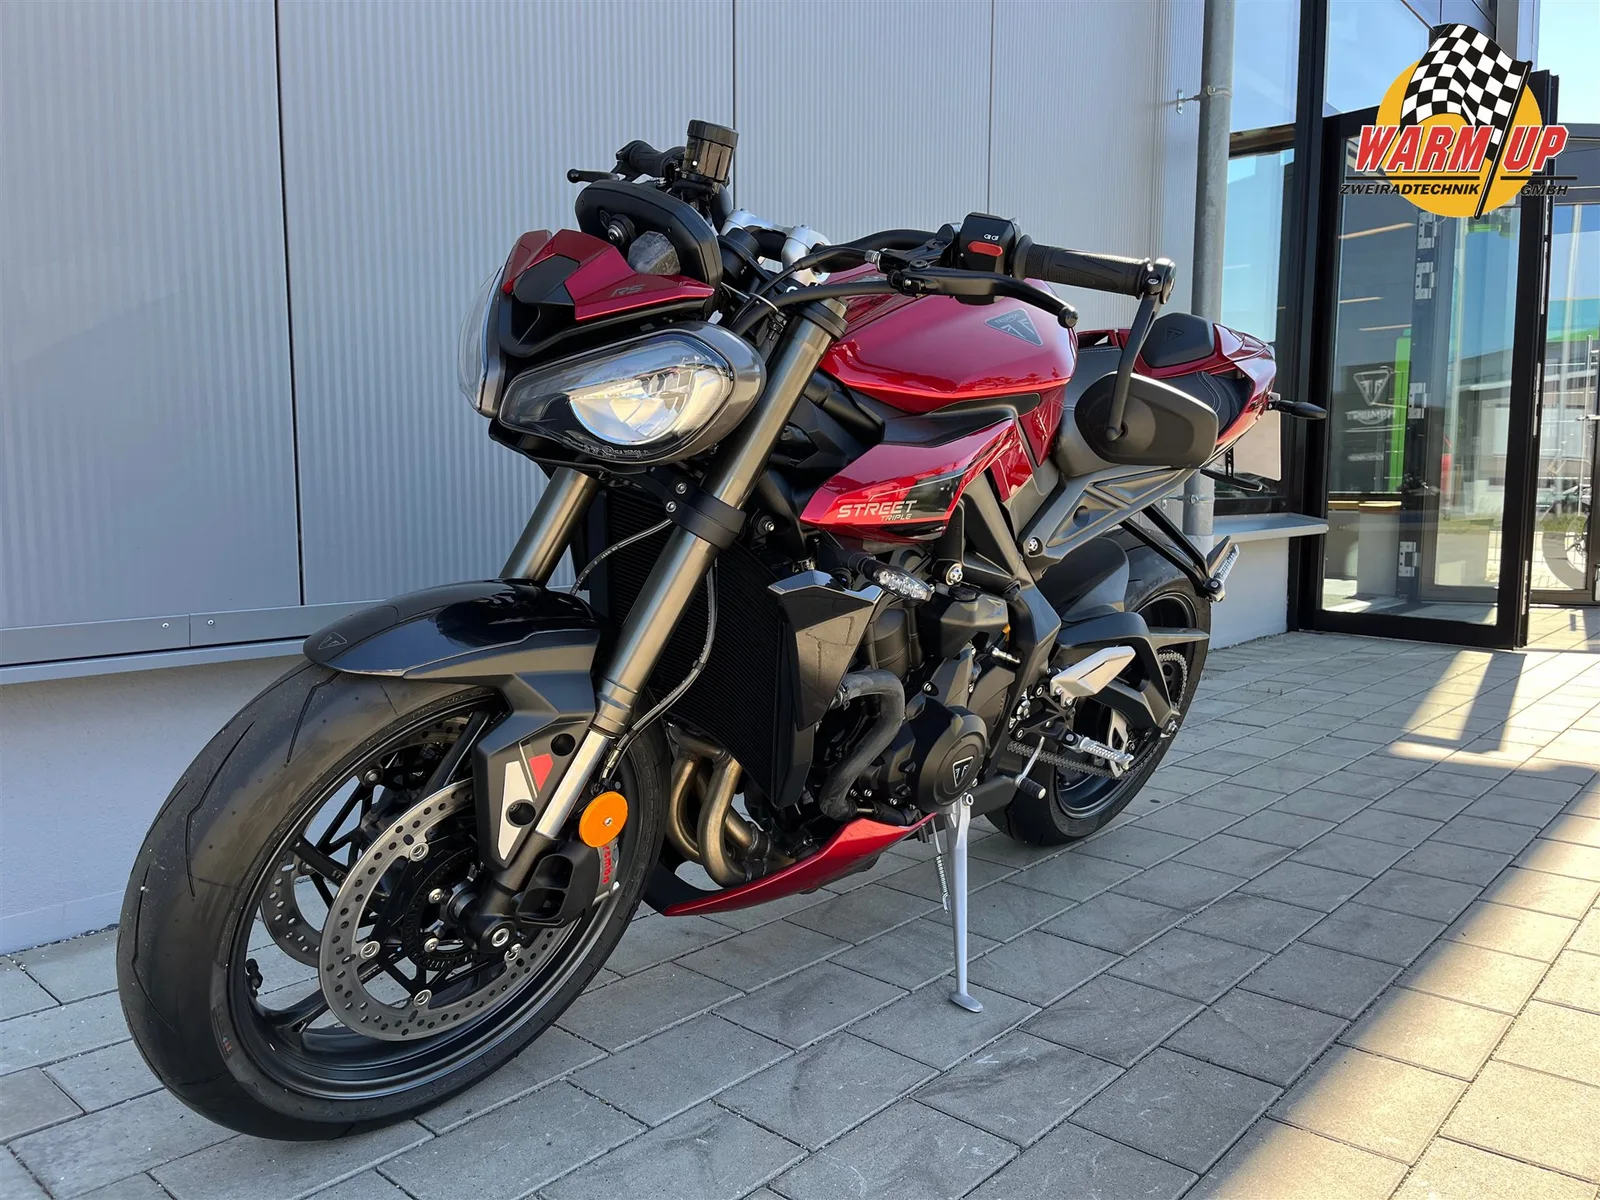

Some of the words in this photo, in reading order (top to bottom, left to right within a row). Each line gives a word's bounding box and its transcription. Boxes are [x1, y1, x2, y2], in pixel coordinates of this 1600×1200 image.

[611, 283, 646, 297] RS
[837, 500, 918, 518] STREET
[881, 513, 912, 521] TRIPLE
[602, 844, 612, 884] rembo
